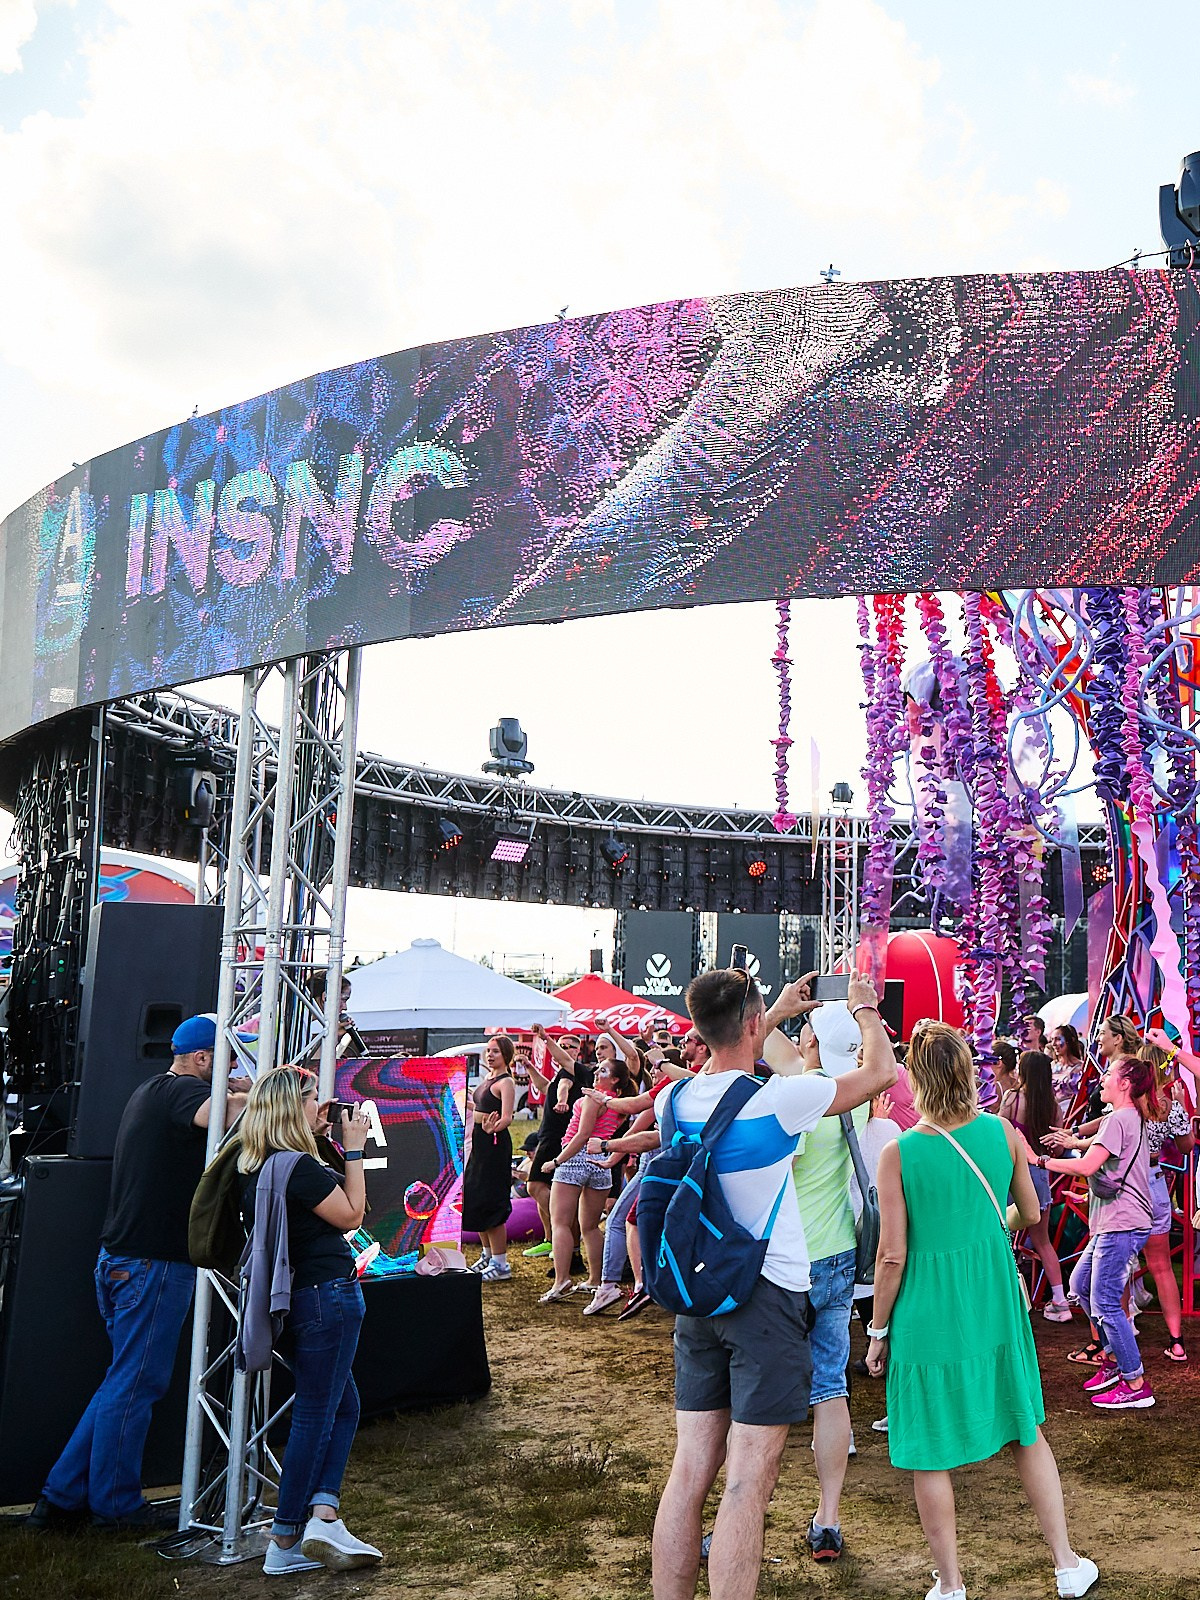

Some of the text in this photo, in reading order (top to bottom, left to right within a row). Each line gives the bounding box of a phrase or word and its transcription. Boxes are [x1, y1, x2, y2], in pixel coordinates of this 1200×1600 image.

[126, 443, 468, 598] INSNC
[644, 977, 672, 987] VIVA
[632, 985, 683, 996] BRASLAV
